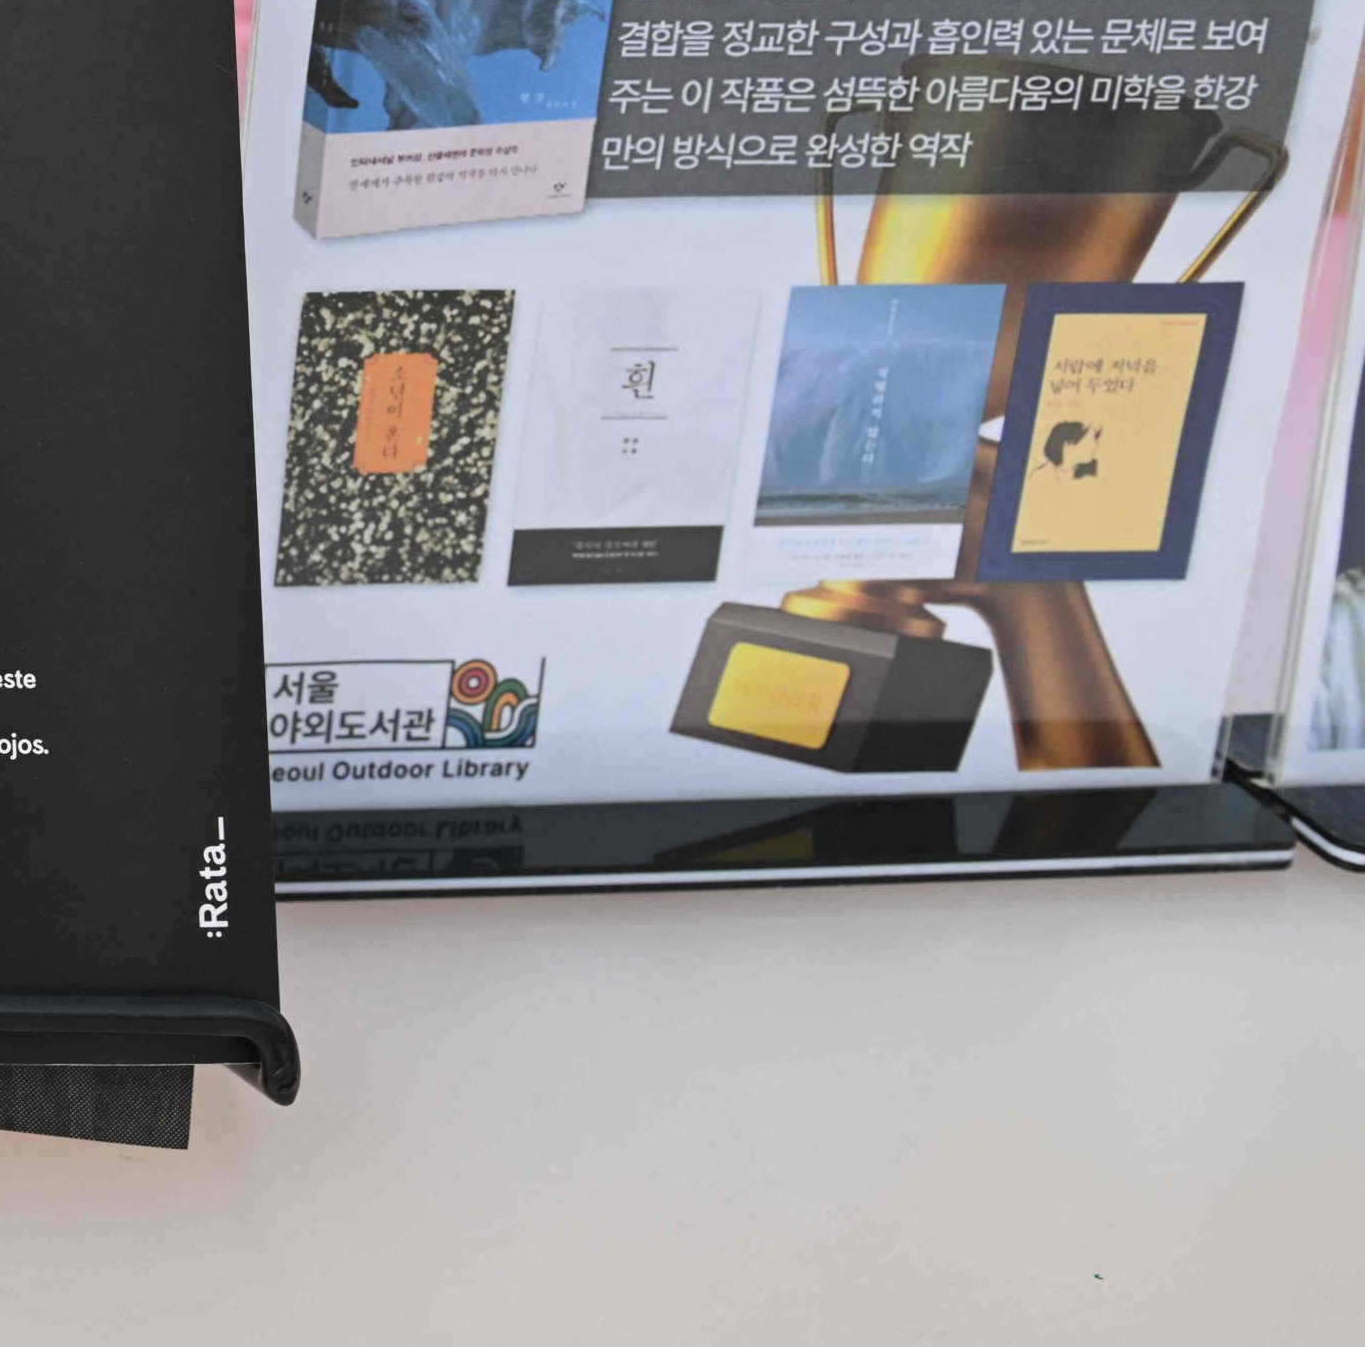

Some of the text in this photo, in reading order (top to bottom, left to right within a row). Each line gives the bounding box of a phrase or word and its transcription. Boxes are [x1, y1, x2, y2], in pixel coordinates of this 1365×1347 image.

[619, 17, 1269, 57] 결합을 정교한 구성과 흡인력 있는 문체로 보여
[609, 78, 673, 114] 주는
[681, 77, 713, 113] 이
[720, 76, 815, 113] 작품은
[823, 75, 919, 112] 섬뜩한
[926, 75, 1080, 112] 아름다움의
[1089, 75, 1184, 110] 미학을
[1192, 74, 1258, 110] 한강
[602, 132, 973, 170] 만의 방식으로 완성한 역작
[621, 360, 655, 399] 흰
[274, 671, 338, 704] 서울
[268, 706, 437, 746] 야외도서관
[268, 757, 531, 784] eoul Outdoor Library
